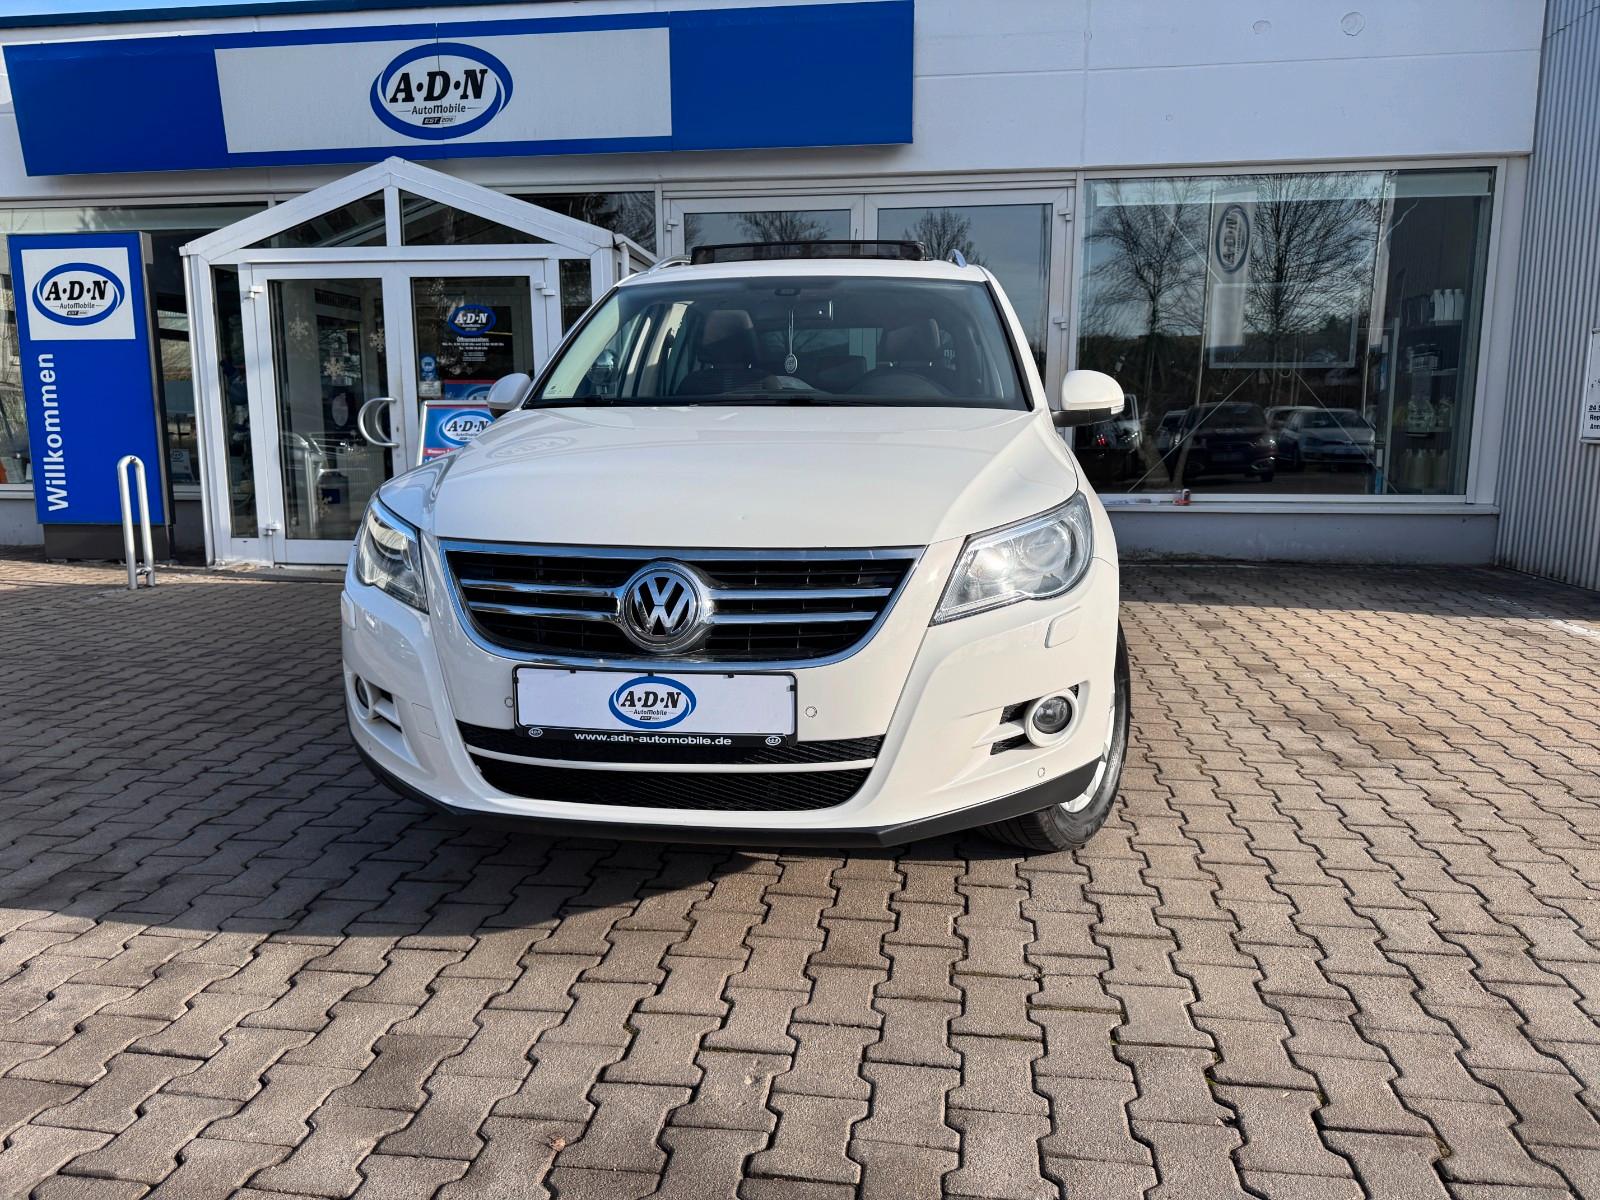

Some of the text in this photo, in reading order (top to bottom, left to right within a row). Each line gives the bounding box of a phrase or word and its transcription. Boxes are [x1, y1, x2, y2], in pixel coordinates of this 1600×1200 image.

[412, 103, 466, 115] AutoMobile
[38, 353, 69, 511] Willkommen
[574, 731, 732, 746] www.adn-automobile.de
